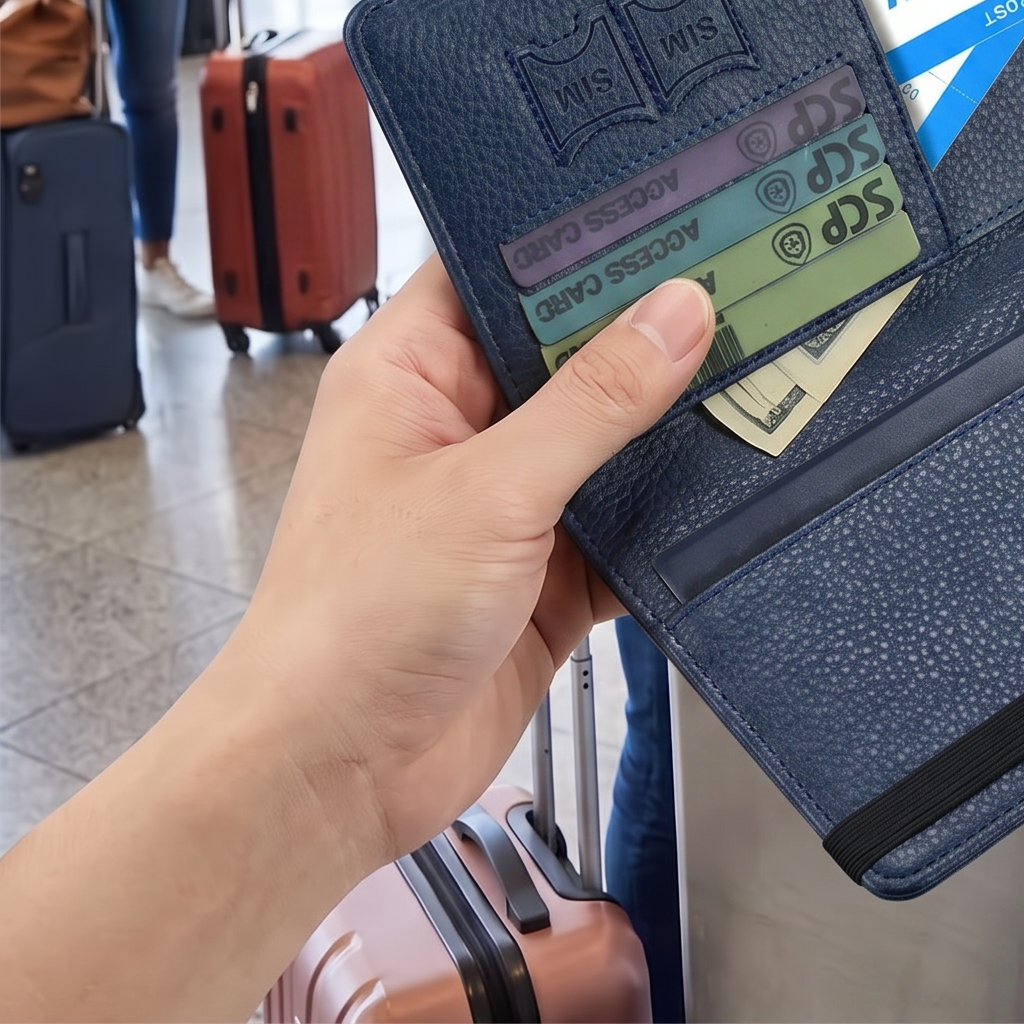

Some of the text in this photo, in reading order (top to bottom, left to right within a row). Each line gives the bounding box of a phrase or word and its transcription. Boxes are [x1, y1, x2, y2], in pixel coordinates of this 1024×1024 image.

[659, 16, 719, 61] SIM
[553, 67, 614, 113] SIM
[512, 76, 862, 271] SCP ACCESS CARD
[806, 124, 880, 194] SCP
[821, 177, 895, 246] SCP
[604, 218, 700, 285] ACCESS
[534, 273, 603, 323] CARD
